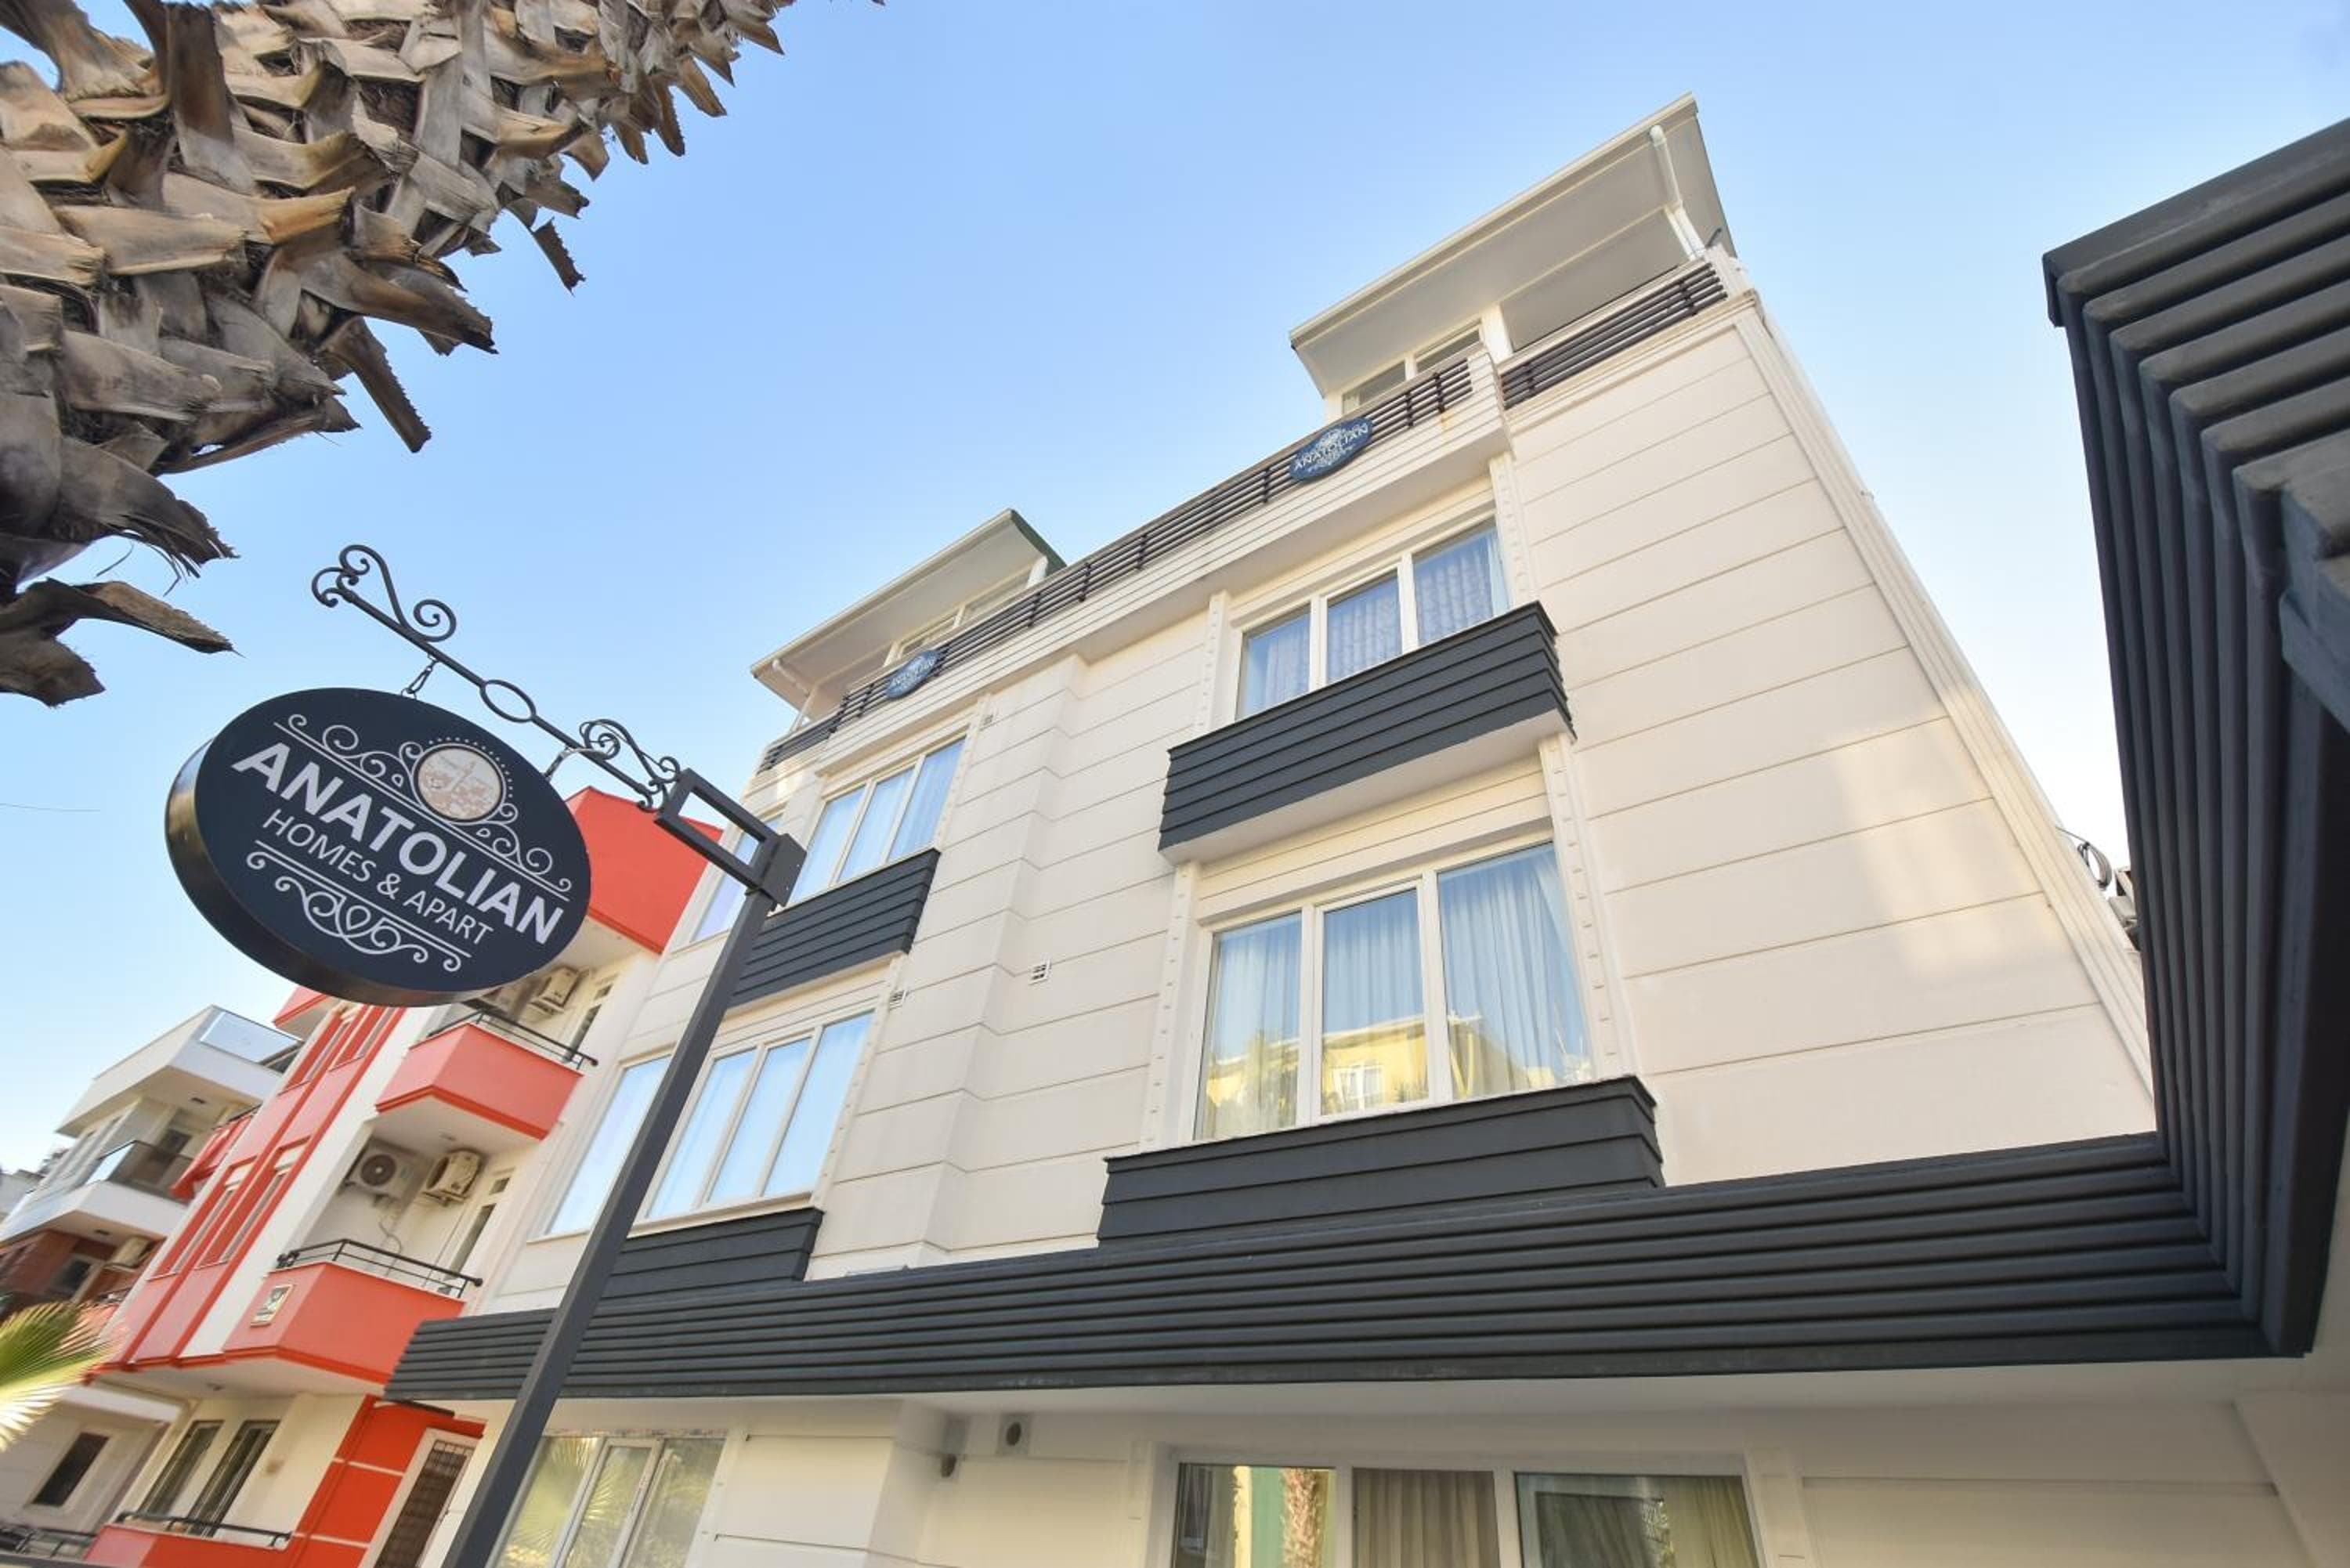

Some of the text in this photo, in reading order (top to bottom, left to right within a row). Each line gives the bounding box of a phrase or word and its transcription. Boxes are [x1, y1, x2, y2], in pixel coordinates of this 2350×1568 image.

[233, 742, 563, 944] ANATOLIAN
[263, 809, 494, 945] HOMES & APART
